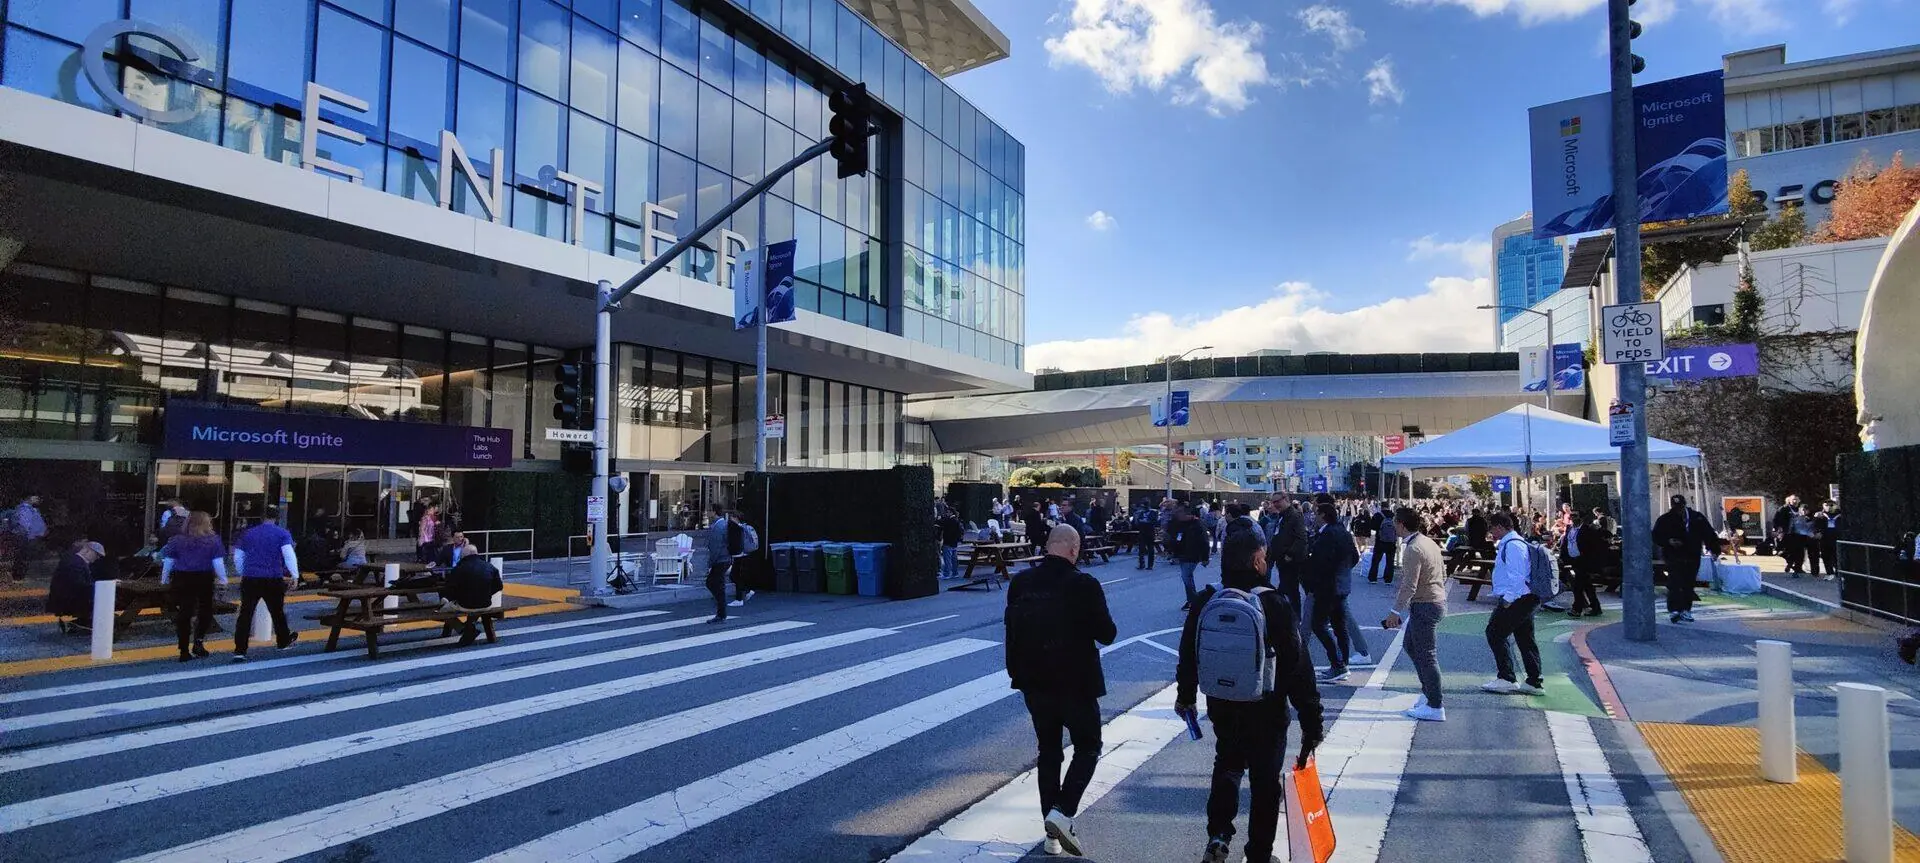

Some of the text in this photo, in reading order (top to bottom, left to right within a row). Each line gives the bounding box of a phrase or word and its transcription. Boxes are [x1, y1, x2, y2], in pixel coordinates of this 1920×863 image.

[1642, 93, 1712, 113] Microsoft
[1643, 113, 1684, 128] Ignite
[1564, 138, 1581, 197] Microsoft
[1612, 327, 1653, 338] YIELD
[1624, 338, 1641, 347] TO
[1616, 348, 1652, 359] PEDS
[1644, 355, 1695, 375] EXIT
[192, 426, 343, 448] Microsoft Ignite
[473, 434, 501, 443] The Hub
[552, 431, 588, 439] Howard
